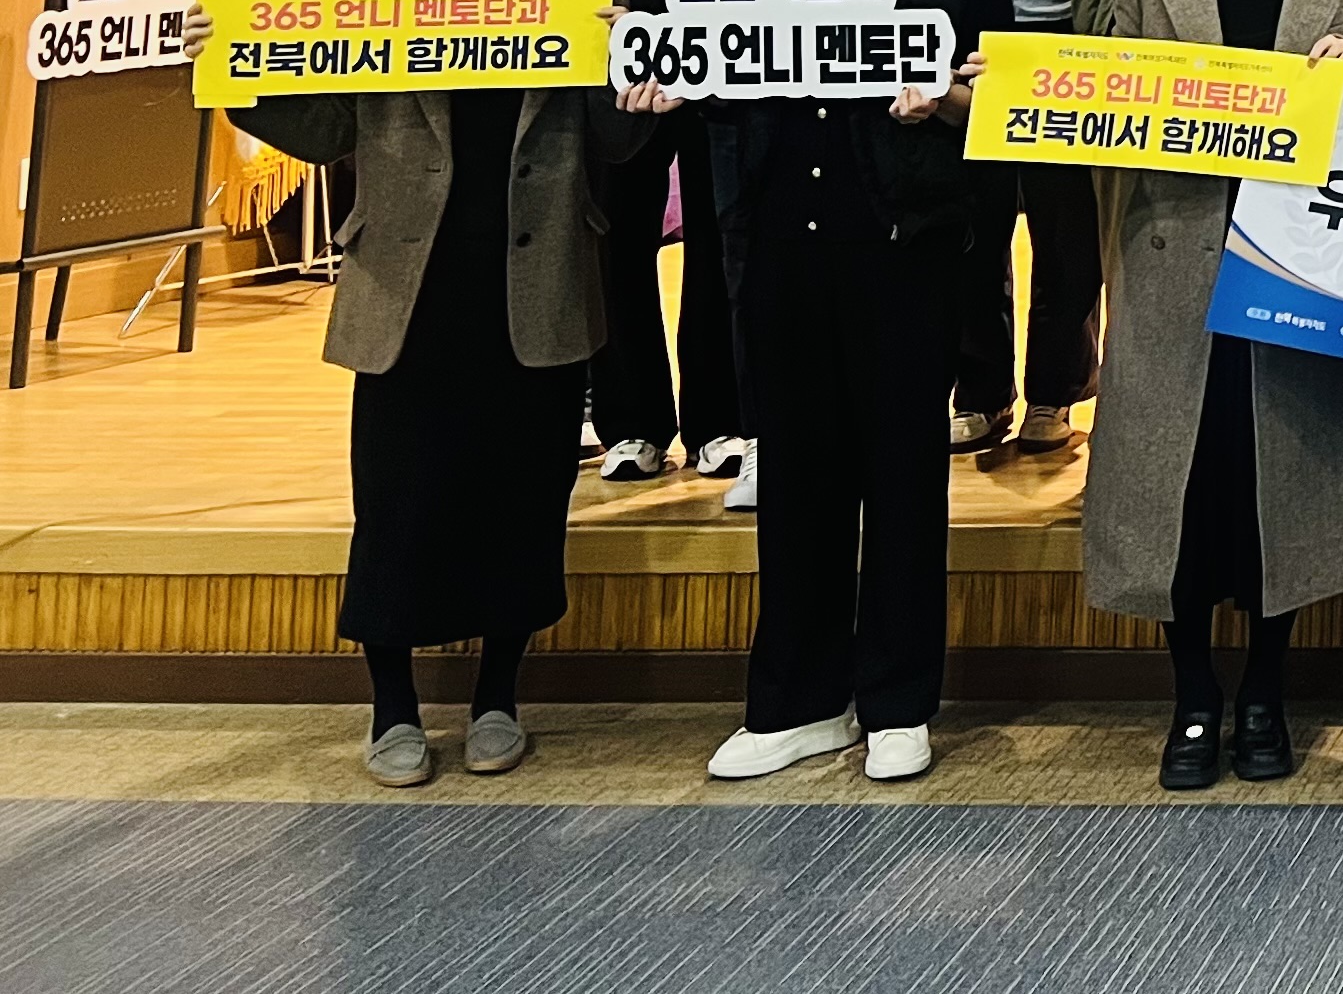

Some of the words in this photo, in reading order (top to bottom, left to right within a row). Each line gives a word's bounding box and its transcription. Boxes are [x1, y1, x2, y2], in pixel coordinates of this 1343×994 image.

[252, 2, 321, 30] 365
[335, 0, 400, 28] 언니
[38, 20, 92, 67] 365
[101, 15, 150, 61] 언니
[230, 40, 390, 77] 전북에서
[407, 36, 569, 72] 함께해요
[623, 26, 708, 86] 365
[720, 24, 802, 84] 언니
[816, 24, 940, 84] 멘토단
[1033, 70, 1094, 99] 365
[1107, 74, 1160, 102] 언니
[1173, 76, 1284, 116] 멘토단과
[1006, 109, 1149, 149] 전북에서
[1162, 118, 1297, 163] 함께해요
